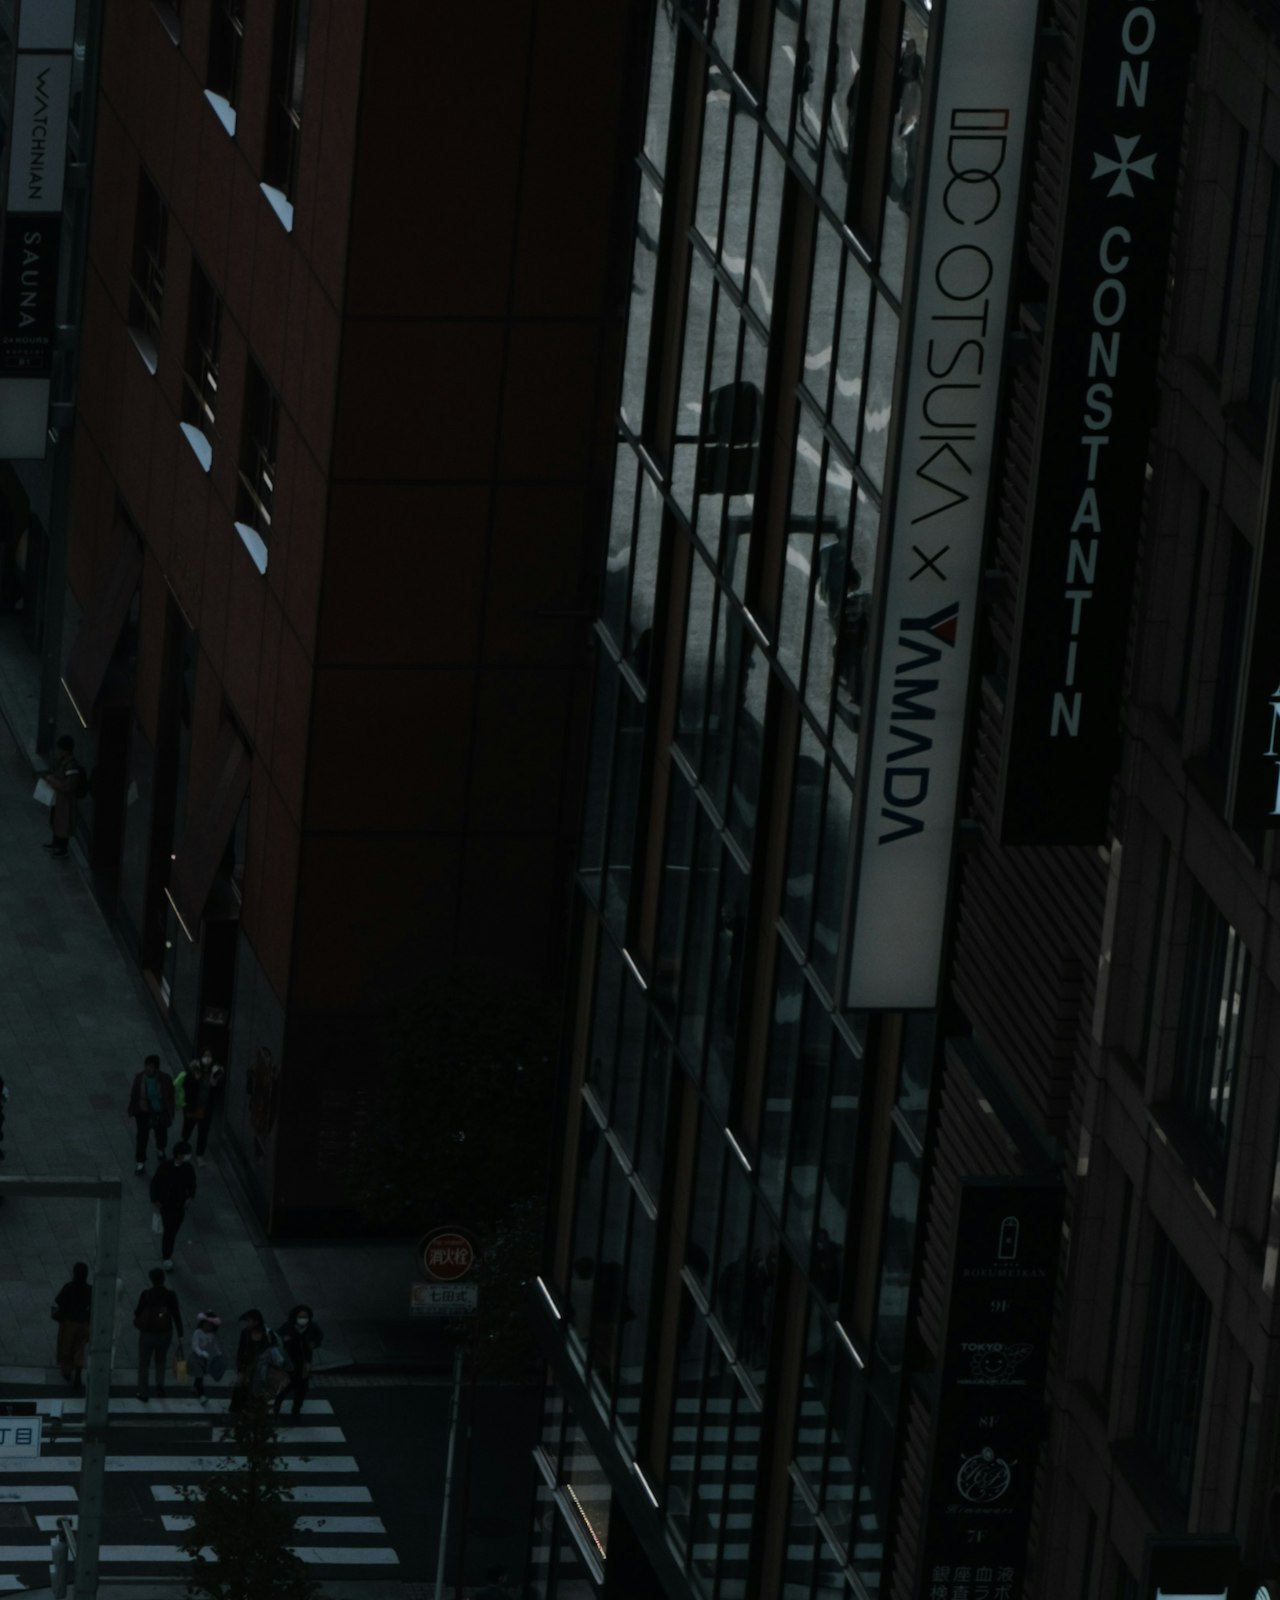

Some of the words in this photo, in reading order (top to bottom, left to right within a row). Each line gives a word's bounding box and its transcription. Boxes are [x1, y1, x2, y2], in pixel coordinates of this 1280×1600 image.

[1115, 0, 1157, 108] ON
[27, 67, 52, 201] WATCHNIAN
[943, 107, 1009, 226] IDC
[17, 231, 43, 329] SAUNA
[910, 243, 994, 526] OTSUKA
[1049, 225, 1133, 738] CONSTANTIN
[877, 600, 961, 845] YAMADA
[428, 1247, 469, 1266] 消火栓
[959, 1341, 1003, 1352] TOKYO
[929, 1583, 1013, 1600] 検査ラボ
[931, 1565, 1015, 1583] 銀座血液
